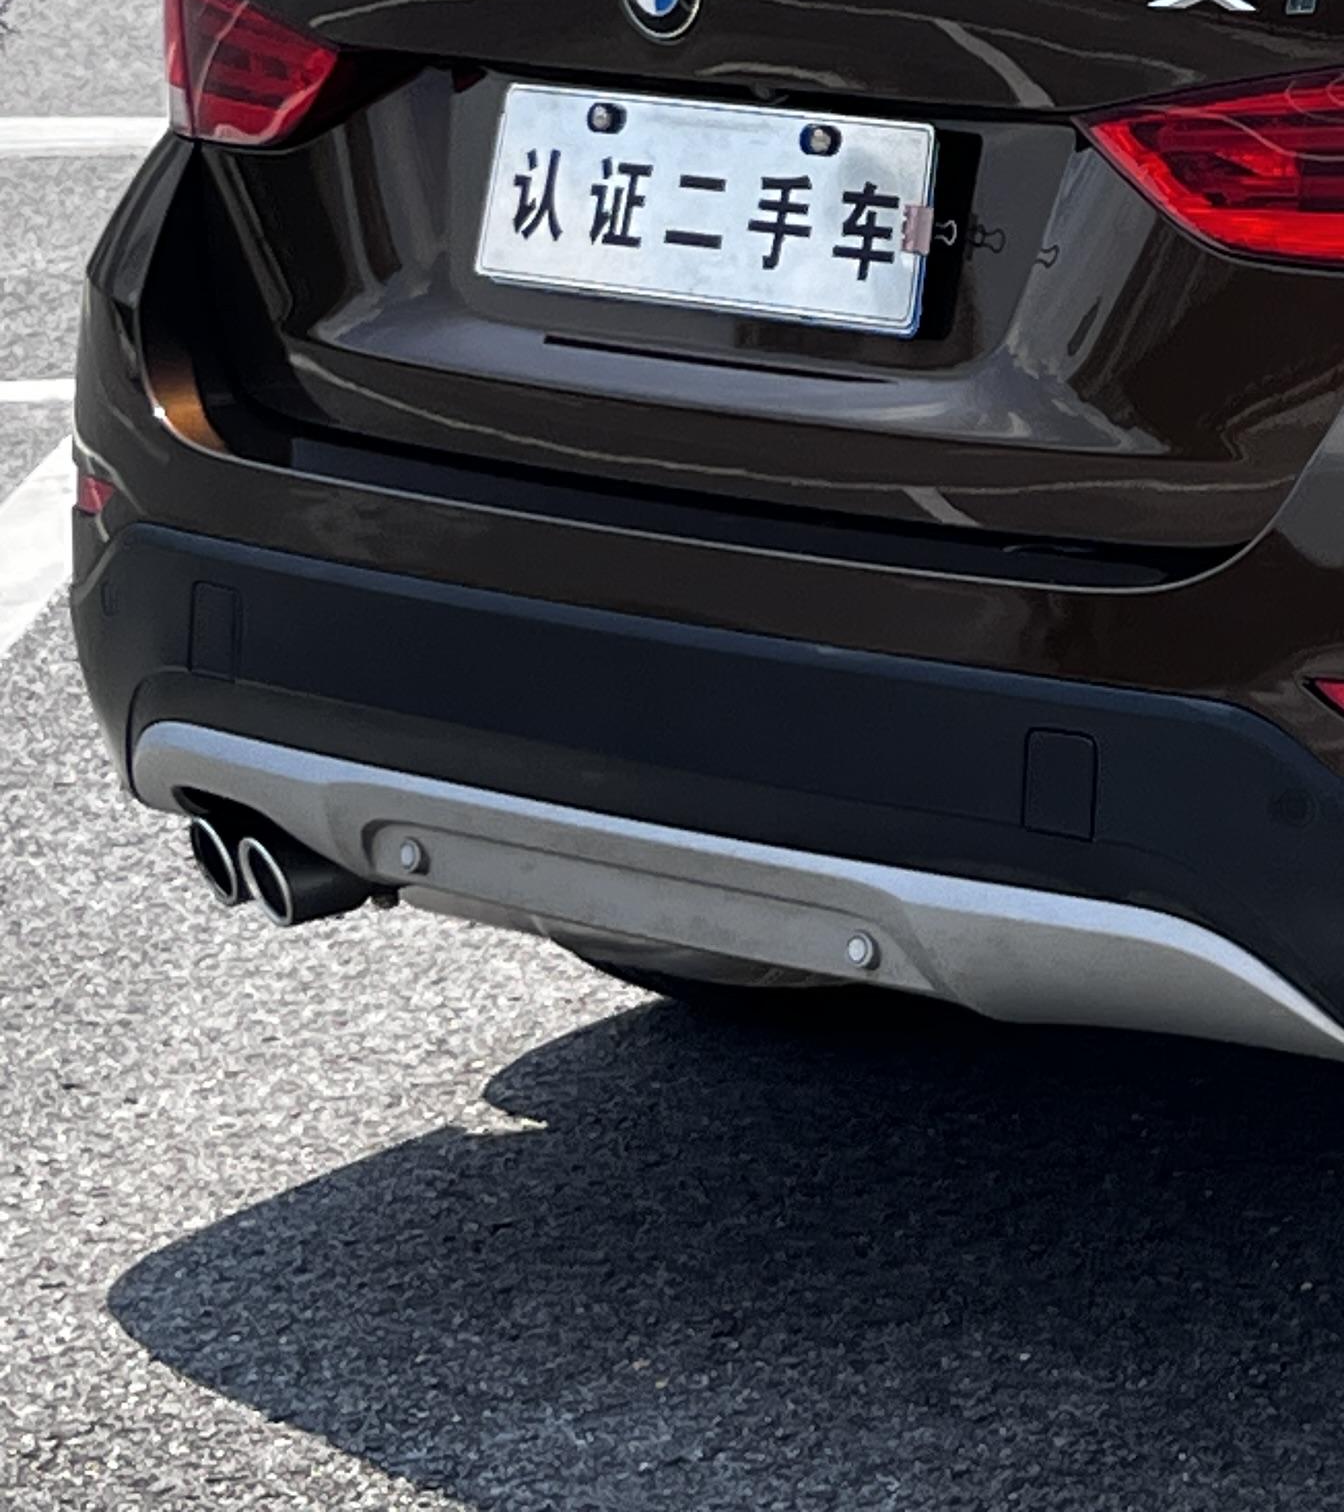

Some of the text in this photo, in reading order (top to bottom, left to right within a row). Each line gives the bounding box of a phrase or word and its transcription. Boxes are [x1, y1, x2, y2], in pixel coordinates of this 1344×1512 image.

[512, 148, 901, 282] 认证二手车
